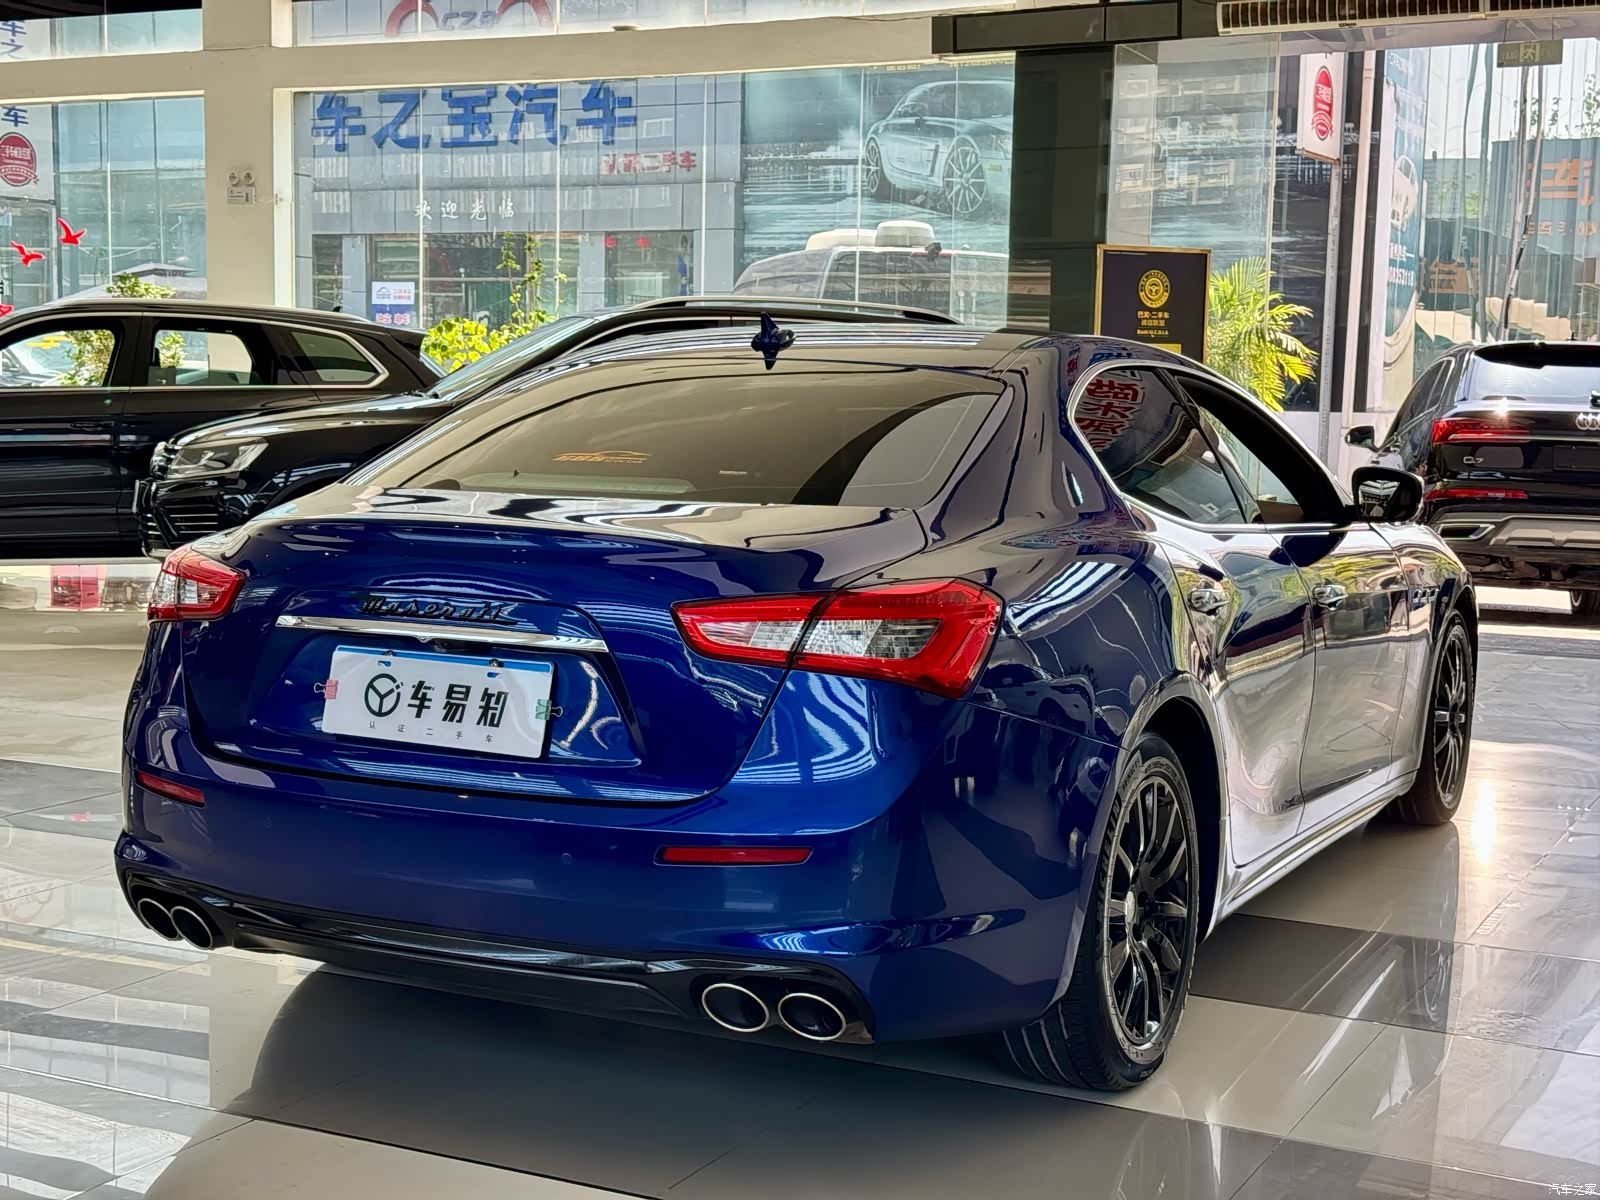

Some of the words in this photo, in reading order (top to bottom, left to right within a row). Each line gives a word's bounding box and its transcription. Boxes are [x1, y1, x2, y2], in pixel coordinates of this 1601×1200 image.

[311, 80, 638, 152] 车之宝汽车
[414, 198, 515, 220] 欢迎光临
[361, 597, 517, 625] Maserati
[407, 679, 510, 728] 车易知
[369, 720, 494, 743] 认证二手车
